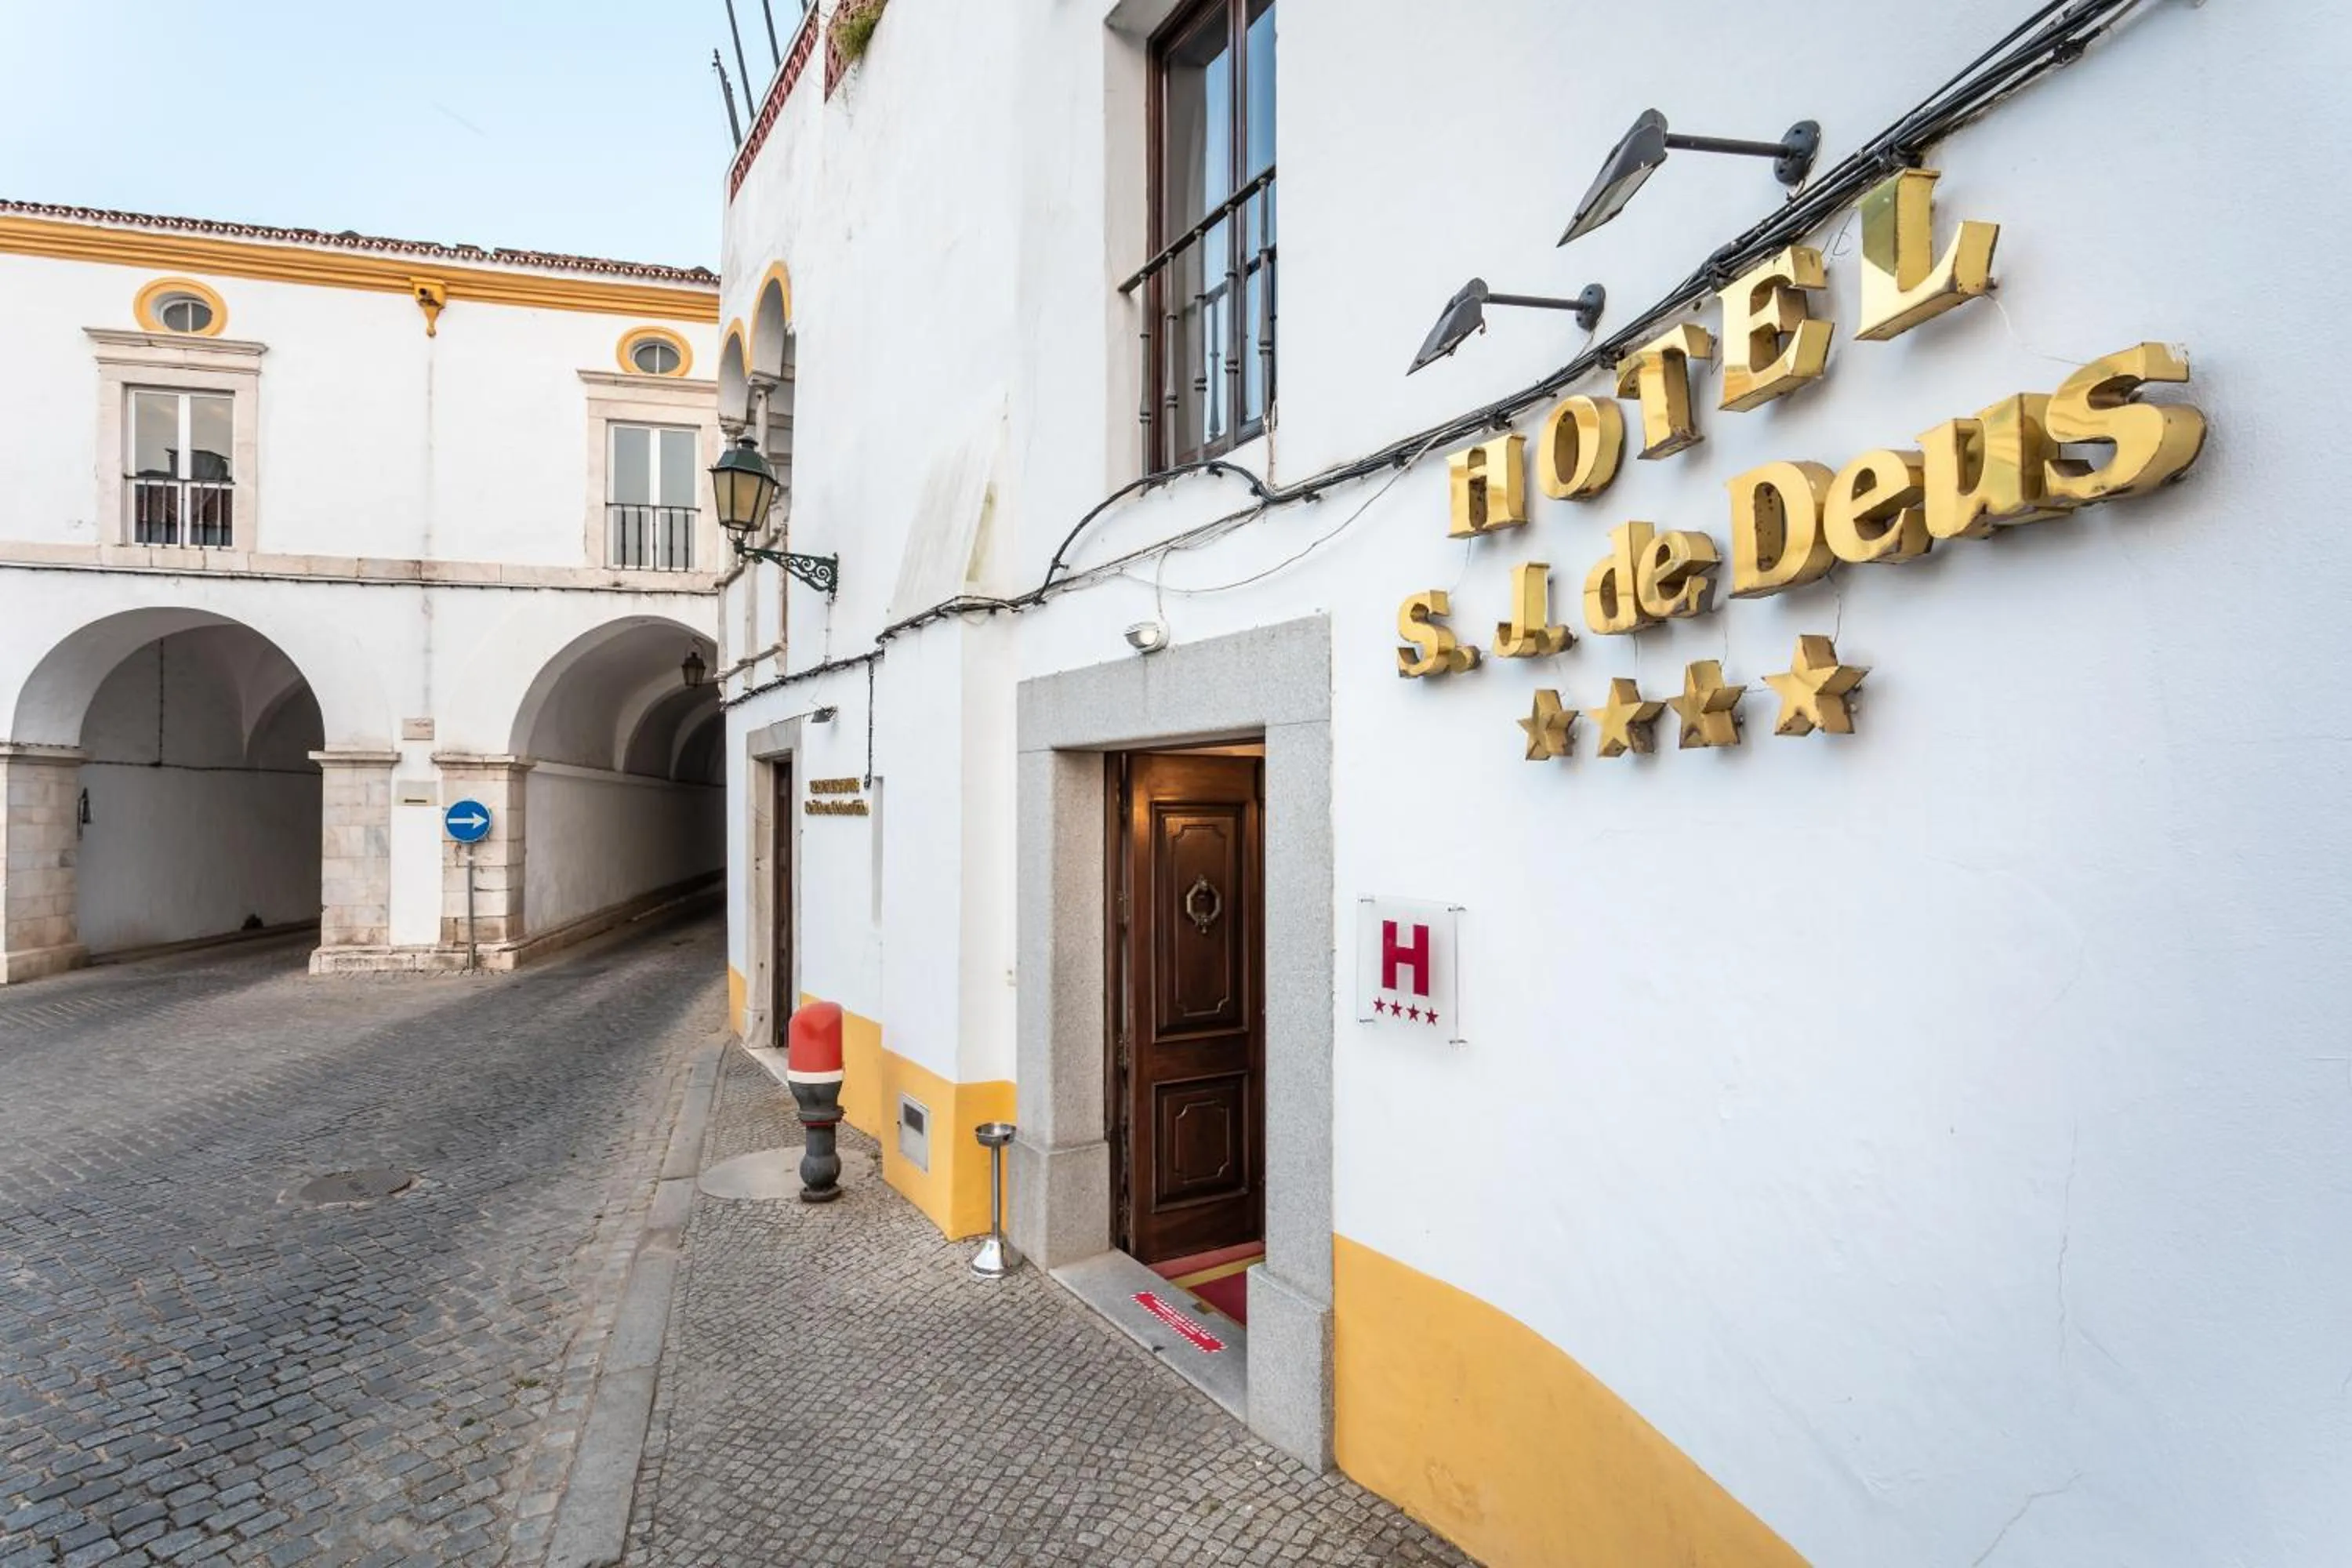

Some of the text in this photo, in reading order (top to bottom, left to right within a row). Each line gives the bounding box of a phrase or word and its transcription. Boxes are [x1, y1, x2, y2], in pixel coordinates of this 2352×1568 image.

[1446, 168, 2000, 539] HOTEL
[1584, 521, 1722, 636] de
[1727, 341, 2208, 600] Deus
[1382, 920, 1429, 997] H
